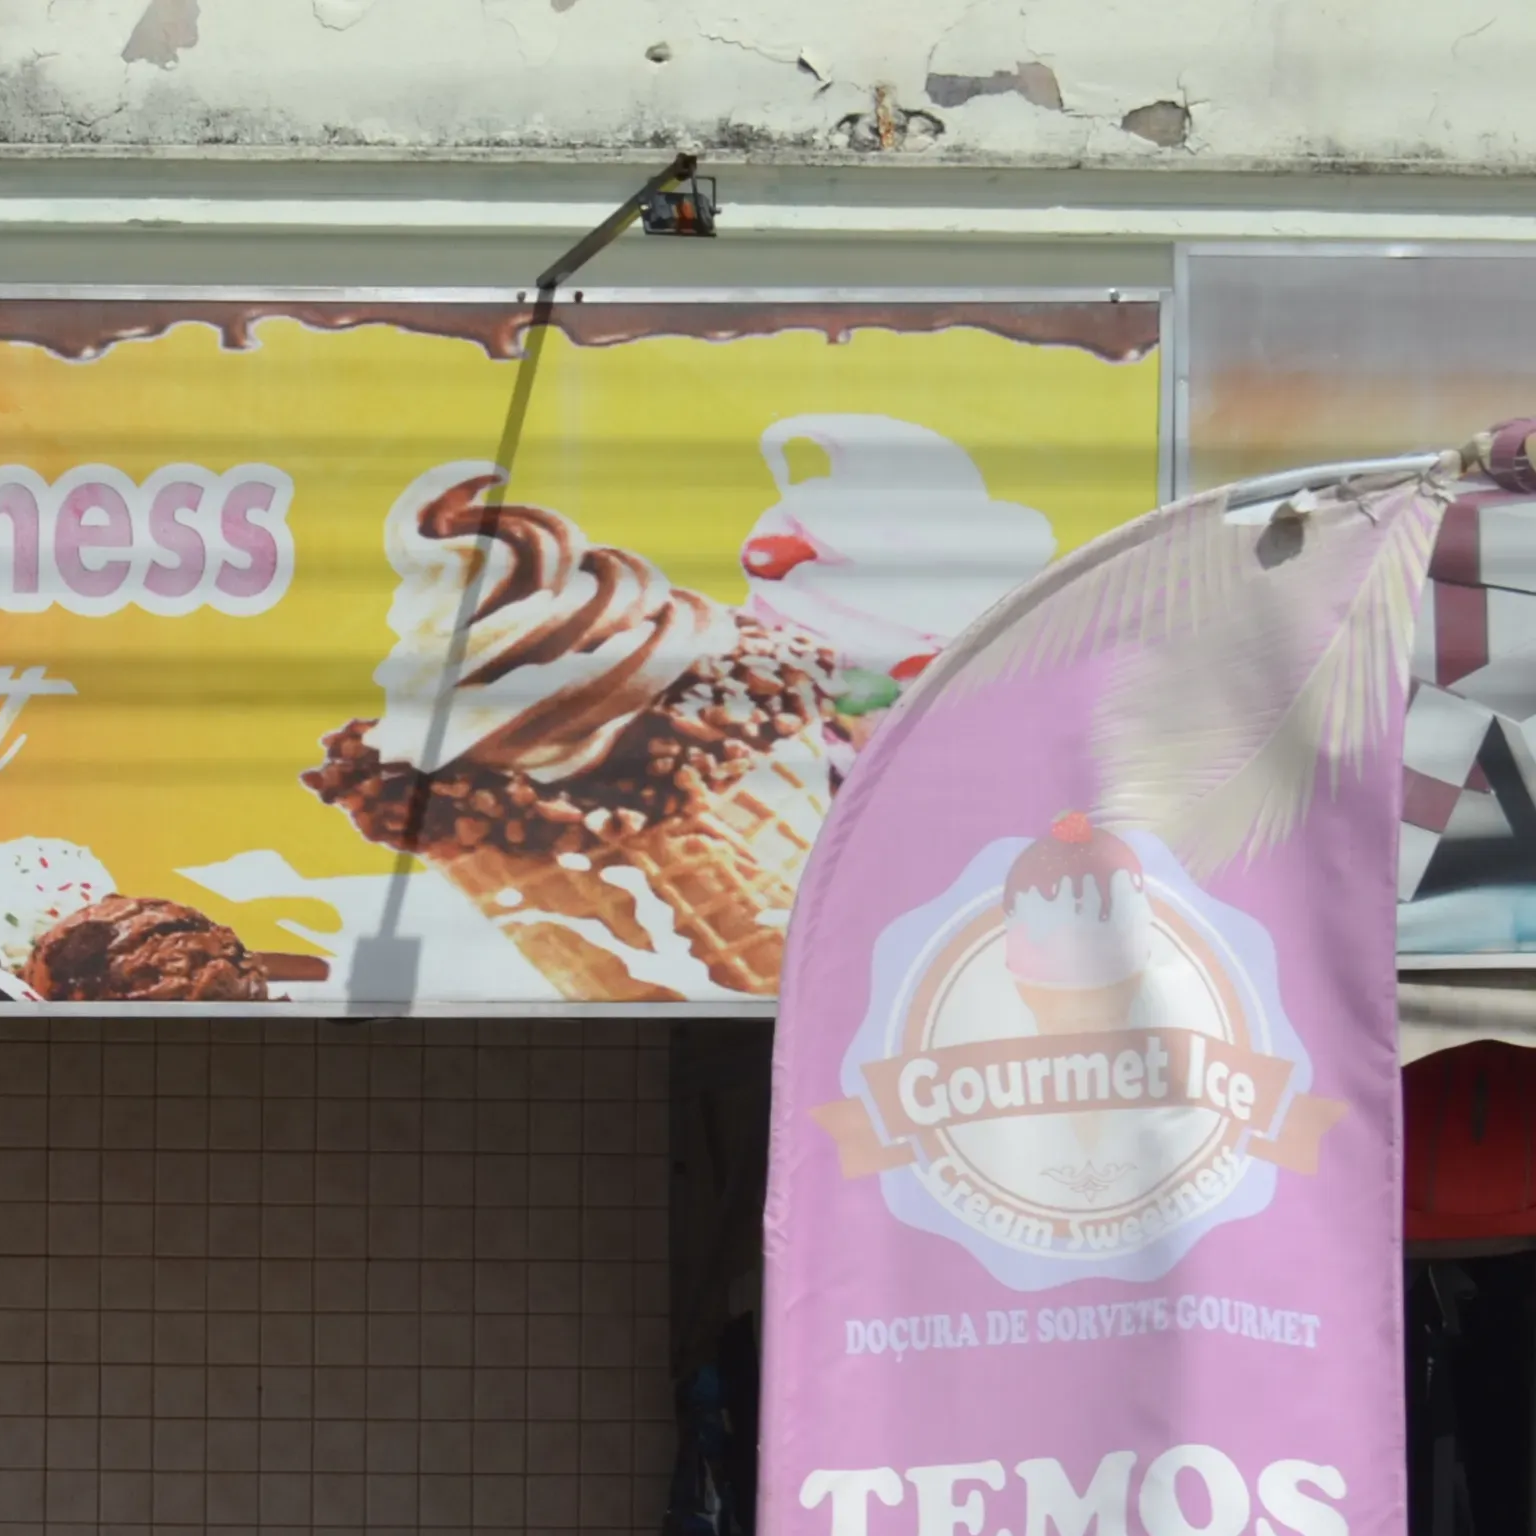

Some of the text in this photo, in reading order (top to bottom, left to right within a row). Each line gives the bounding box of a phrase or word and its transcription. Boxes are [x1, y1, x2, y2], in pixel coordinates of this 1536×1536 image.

[898, 1035, 1256, 1125] Gourmet Ice
[927, 1147, 1241, 1252] Cream Sweetness
[845, 1296, 1322, 1362] DOÇURA DE SORVETE GOURMET
